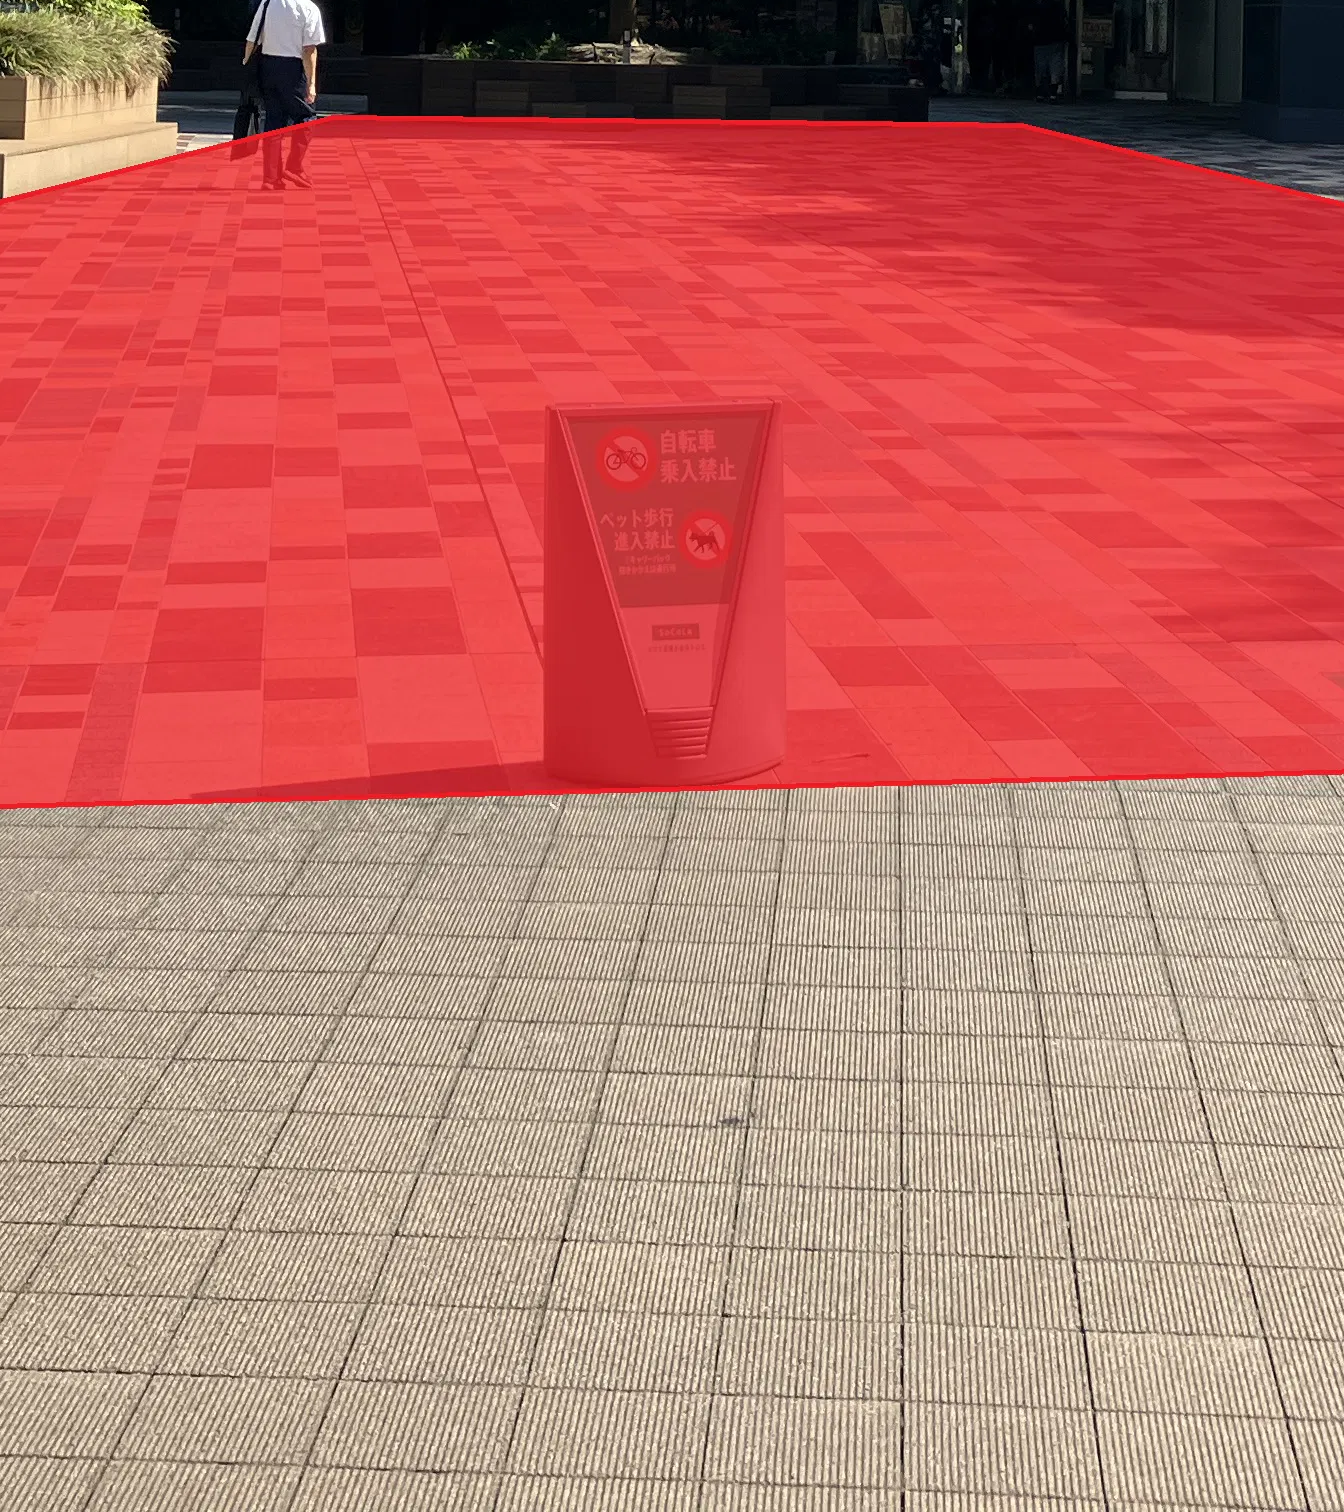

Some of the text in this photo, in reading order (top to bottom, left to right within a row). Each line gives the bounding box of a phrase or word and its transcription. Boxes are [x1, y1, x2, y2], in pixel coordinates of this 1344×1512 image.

[660, 428, 716, 454] 自転車
[660, 457, 737, 483] 乗入禁止
[600, 508, 673, 528] ペット歩行
[614, 531, 675, 552] 進入禁止
